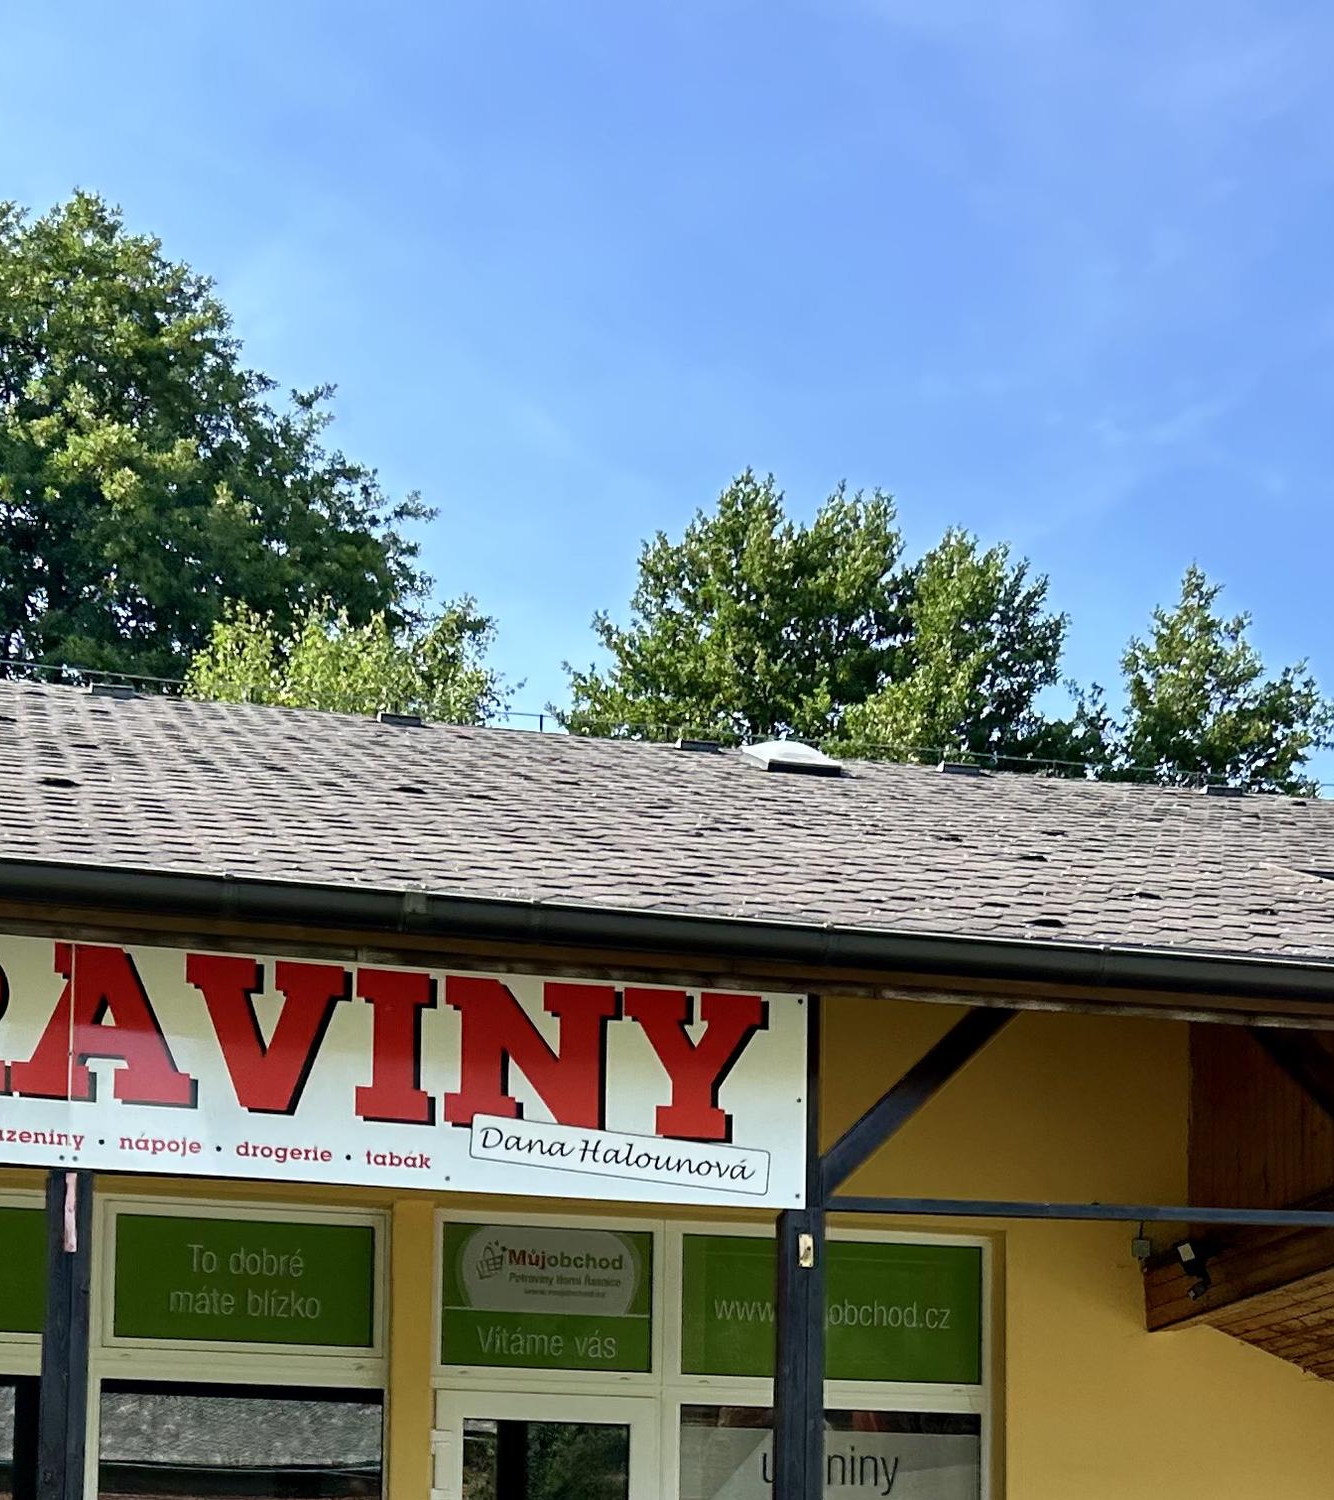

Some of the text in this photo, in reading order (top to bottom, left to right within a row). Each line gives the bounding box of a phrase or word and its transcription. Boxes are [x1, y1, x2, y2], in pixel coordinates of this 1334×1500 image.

[119, 1131, 202, 1156] nápoje
[235, 1141, 333, 1165] drogerie
[365, 1148, 432, 1170] tabák
[478, 1126, 756, 1181] Dana Halounová
[187, 1243, 304, 1278] To dobré
[169, 1284, 321, 1320] máte blízko
[476, 1325, 617, 1359] Vítáme vás
[761, 1446, 899, 1497] uniny
